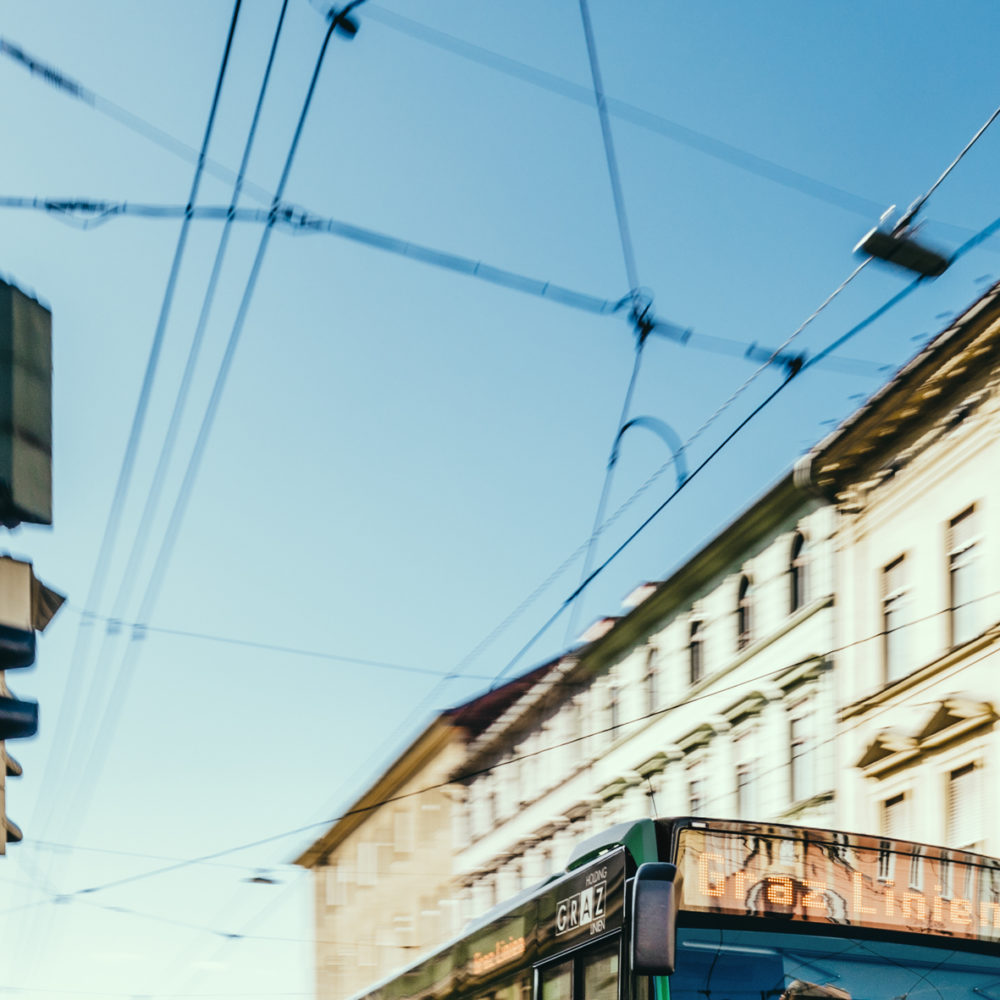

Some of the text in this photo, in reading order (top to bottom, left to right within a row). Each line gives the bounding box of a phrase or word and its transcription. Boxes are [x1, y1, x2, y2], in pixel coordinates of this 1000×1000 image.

[556, 886, 604, 932] GRAZ
[698, 852, 1000, 929] Graz Linien
